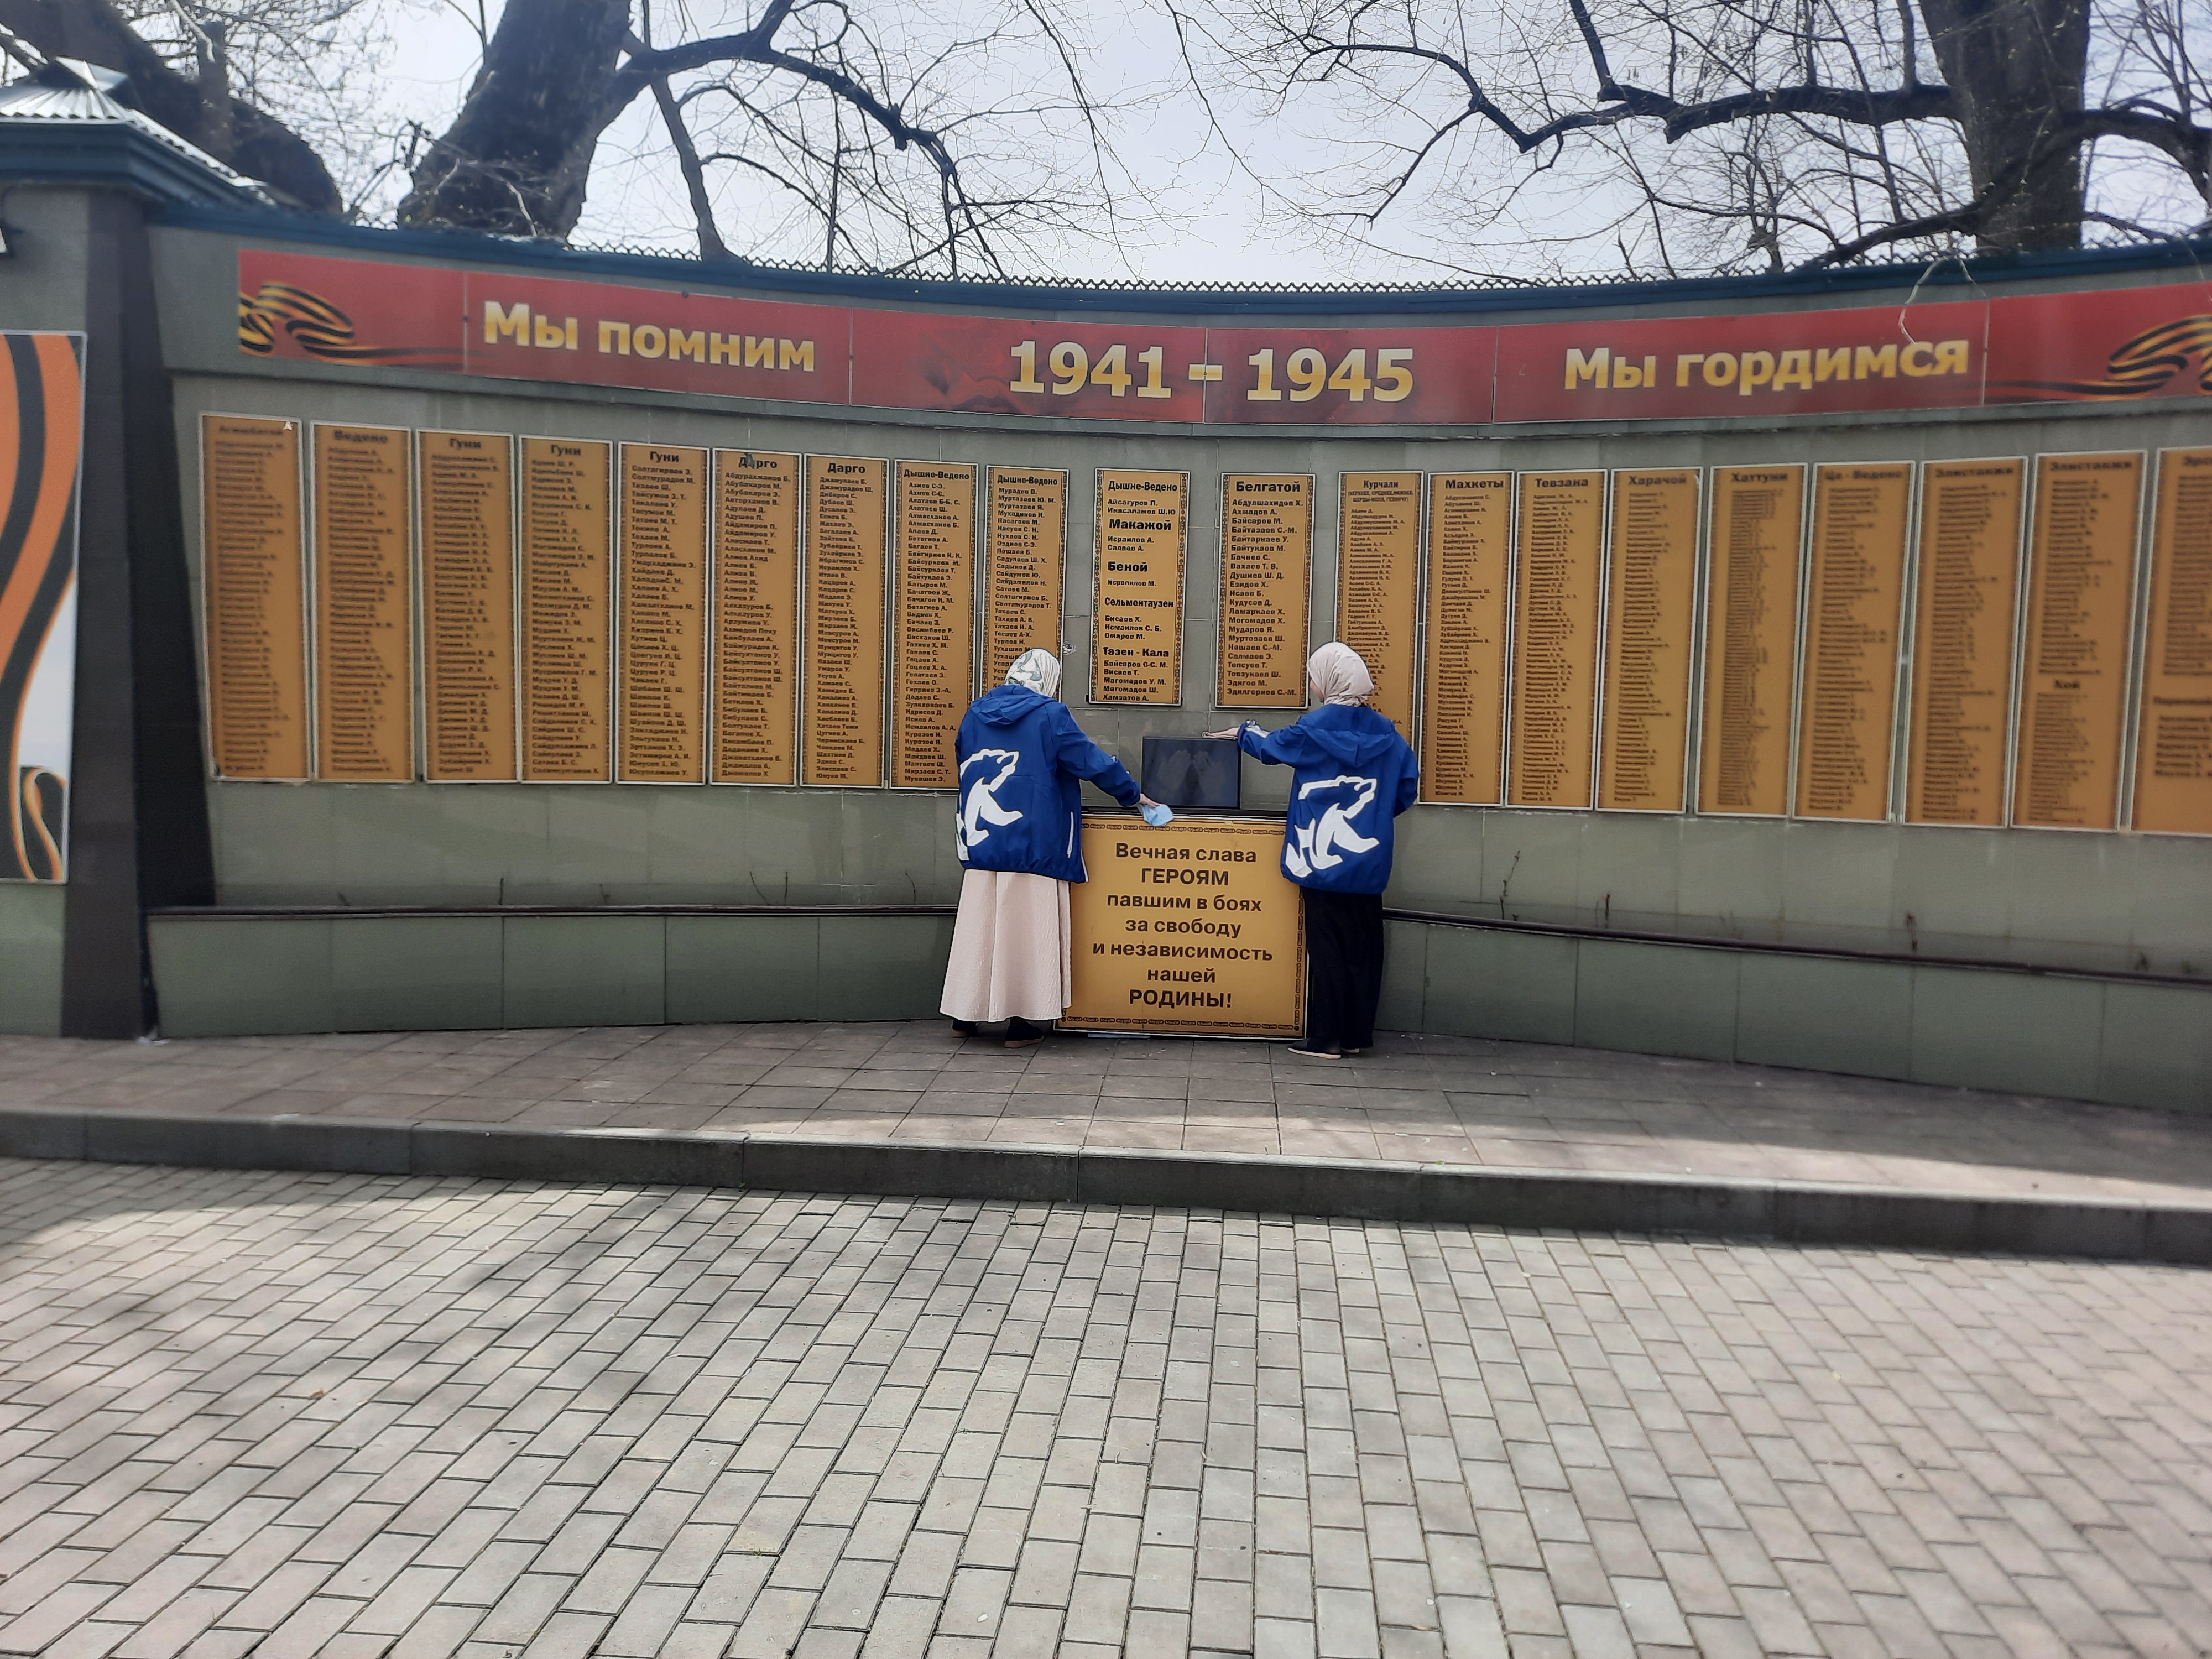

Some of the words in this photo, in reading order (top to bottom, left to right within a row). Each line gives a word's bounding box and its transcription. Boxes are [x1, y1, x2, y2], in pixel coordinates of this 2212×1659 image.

[485, 301, 577, 350] Мы
[598, 320, 815, 372] помним
[1010, 341, 1171, 398] 1941
[1248, 348, 1413, 401] 1945
[1566, 348, 1656, 389] Мы
[1676, 339, 1969, 395] гордимся
[450, 438, 481, 450] Гуни
[551, 444, 581, 456] Гуни
[650, 451, 679, 463] Гуни
[738, 457, 778, 469] Дрго
[827, 462, 866, 474] Дарго
[904, 469, 969, 480] Дышне-Ведено
[997, 474, 1058, 486] Дышне-Ведено
[1629, 474, 1687, 486] Харачой
[1108, 480, 1177, 493] Дышне-Ведено
[1235, 481, 1300, 492] Белгатой
[1363, 479, 1399, 489] Курчали
[1445, 479, 1504, 489] Махкеты
[1109, 518, 1171, 531] Макажой
[1108, 561, 1147, 572] Беной
[1276, 572, 1284, 580] Д.
[1104, 597, 1173, 608] Сельментаузен
[1264, 599, 1272, 607] Д.
[1102, 646, 1134, 656] Тазен
[1142, 648, 1169, 658] Кала
[1103, 676, 1147, 685] Магомадов
[1103, 685, 1147, 693] Магомадов
[1116, 842, 1190, 860] Вечная
[1196, 848, 1256, 863] слава
[1141, 868, 1229, 886] ГЕРОЯМ
[1107, 895, 1191, 909] павшим
[1197, 898, 1208, 910] в
[1213, 894, 1262, 912] боях
[1125, 920, 1149, 932] за
[1154, 917, 1241, 939] свободу
[1093, 943, 1105, 954] и
[1110, 943, 1273, 961] независимость
[1147, 967, 1215, 983] нашей
[1129, 989, 1232, 1009] РОДИНЫ!
